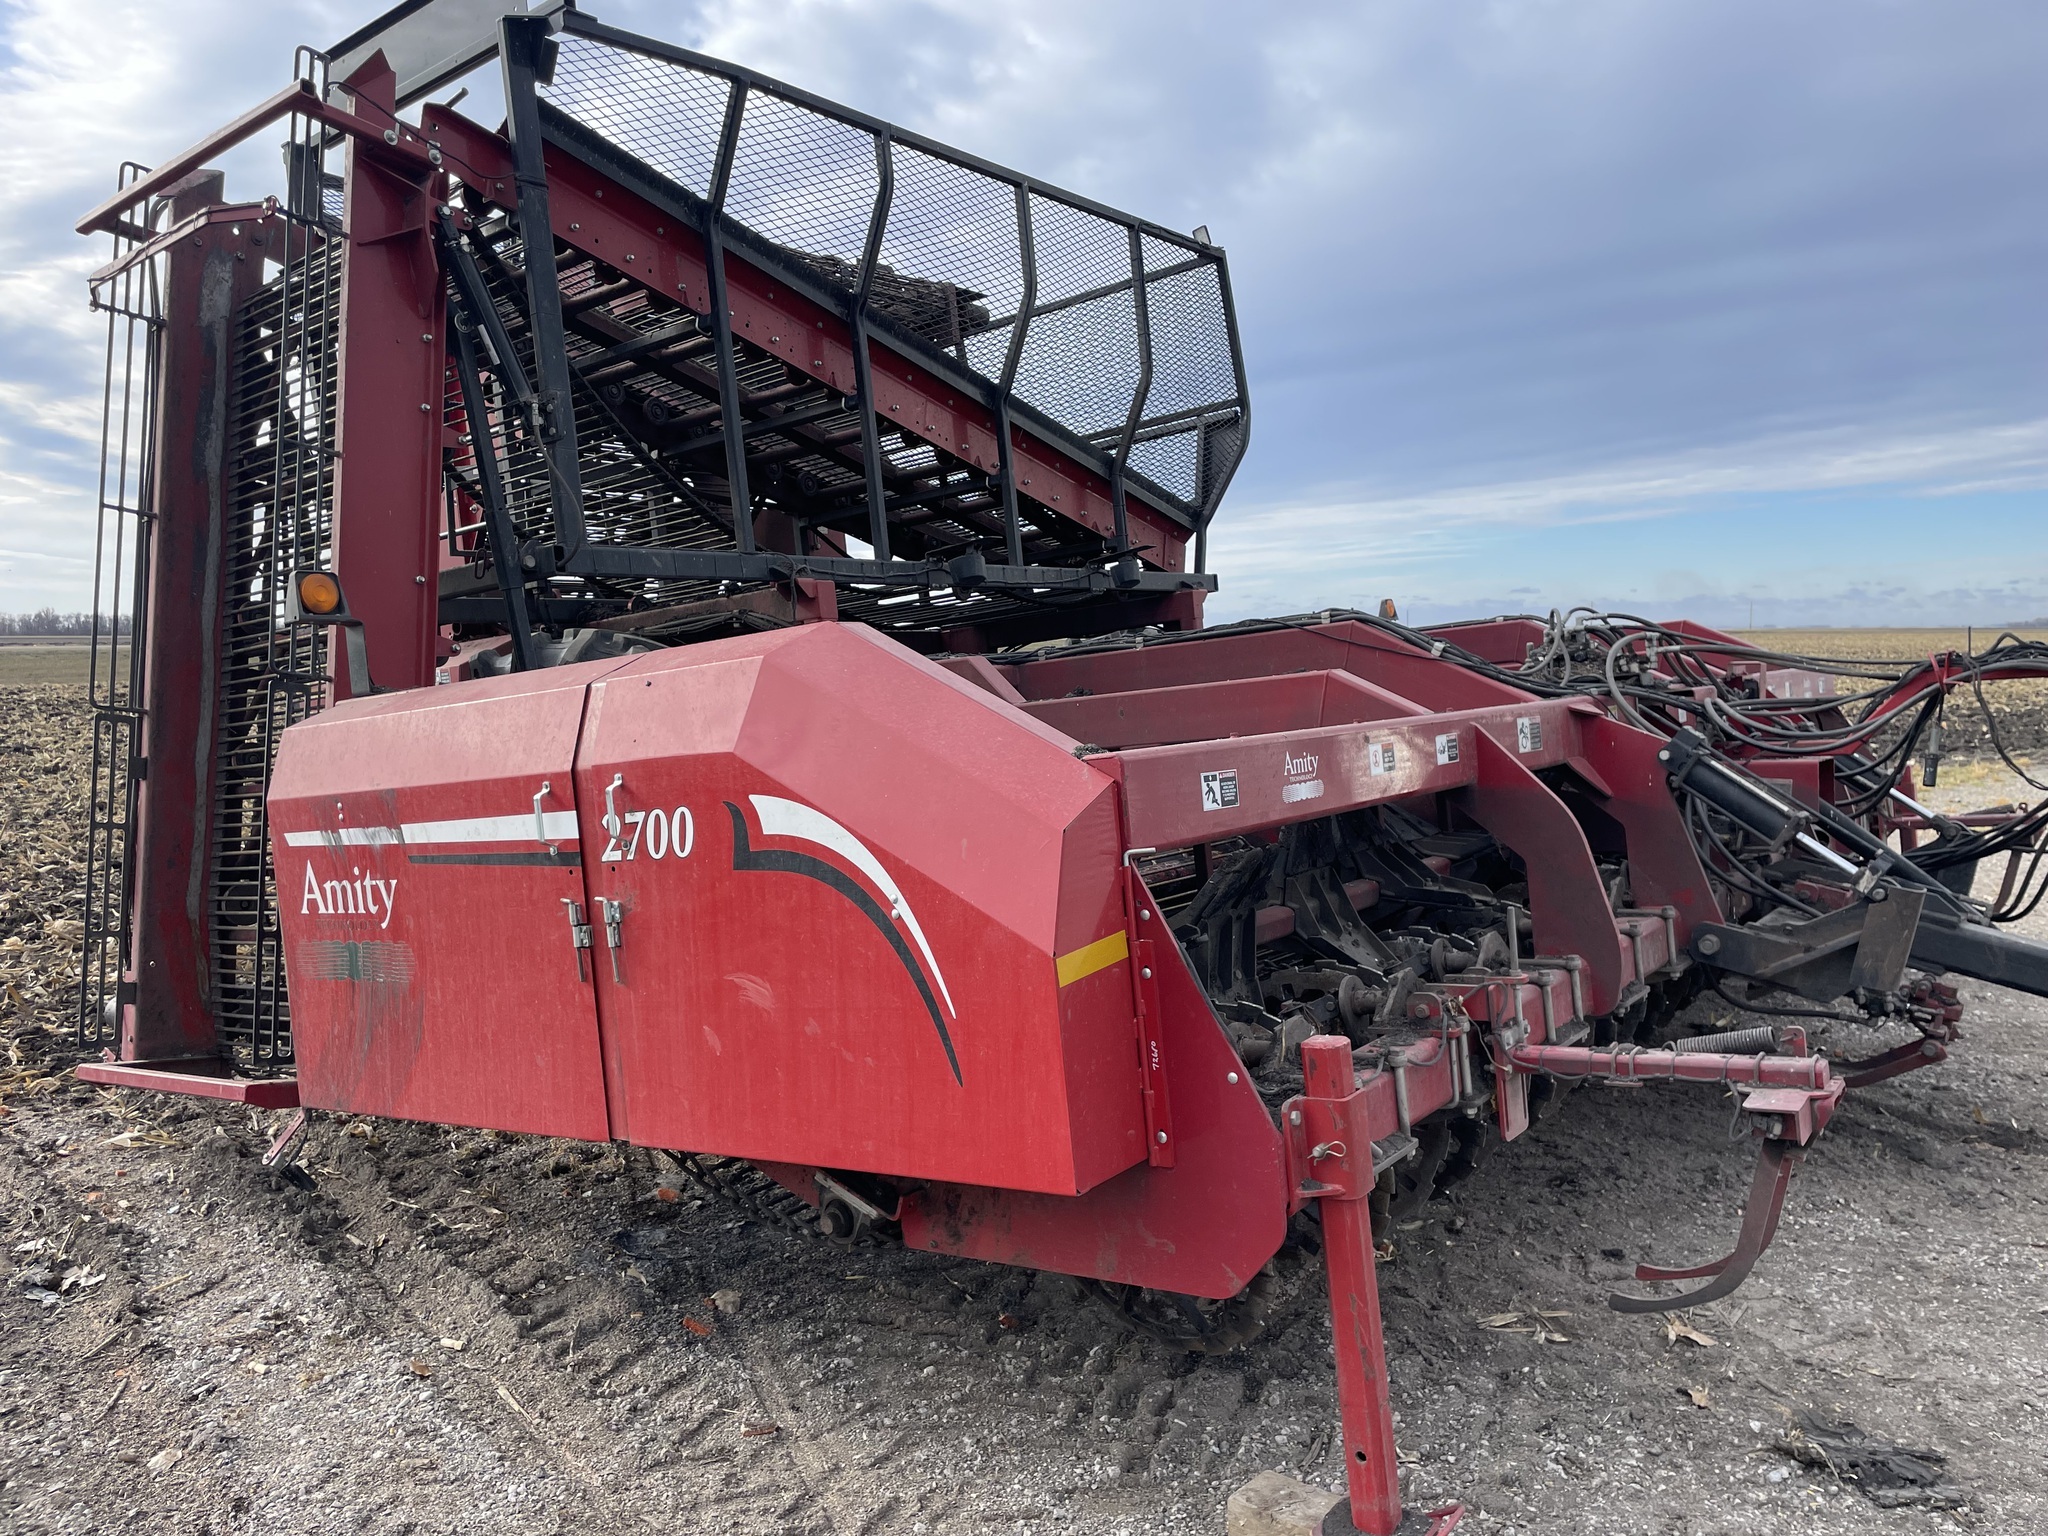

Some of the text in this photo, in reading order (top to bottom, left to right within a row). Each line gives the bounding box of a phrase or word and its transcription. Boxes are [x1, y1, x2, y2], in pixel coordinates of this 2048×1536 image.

[1284, 751, 1318, 777] Amity
[601, 806, 694, 862] 2700
[301, 859, 397, 929] Amity
